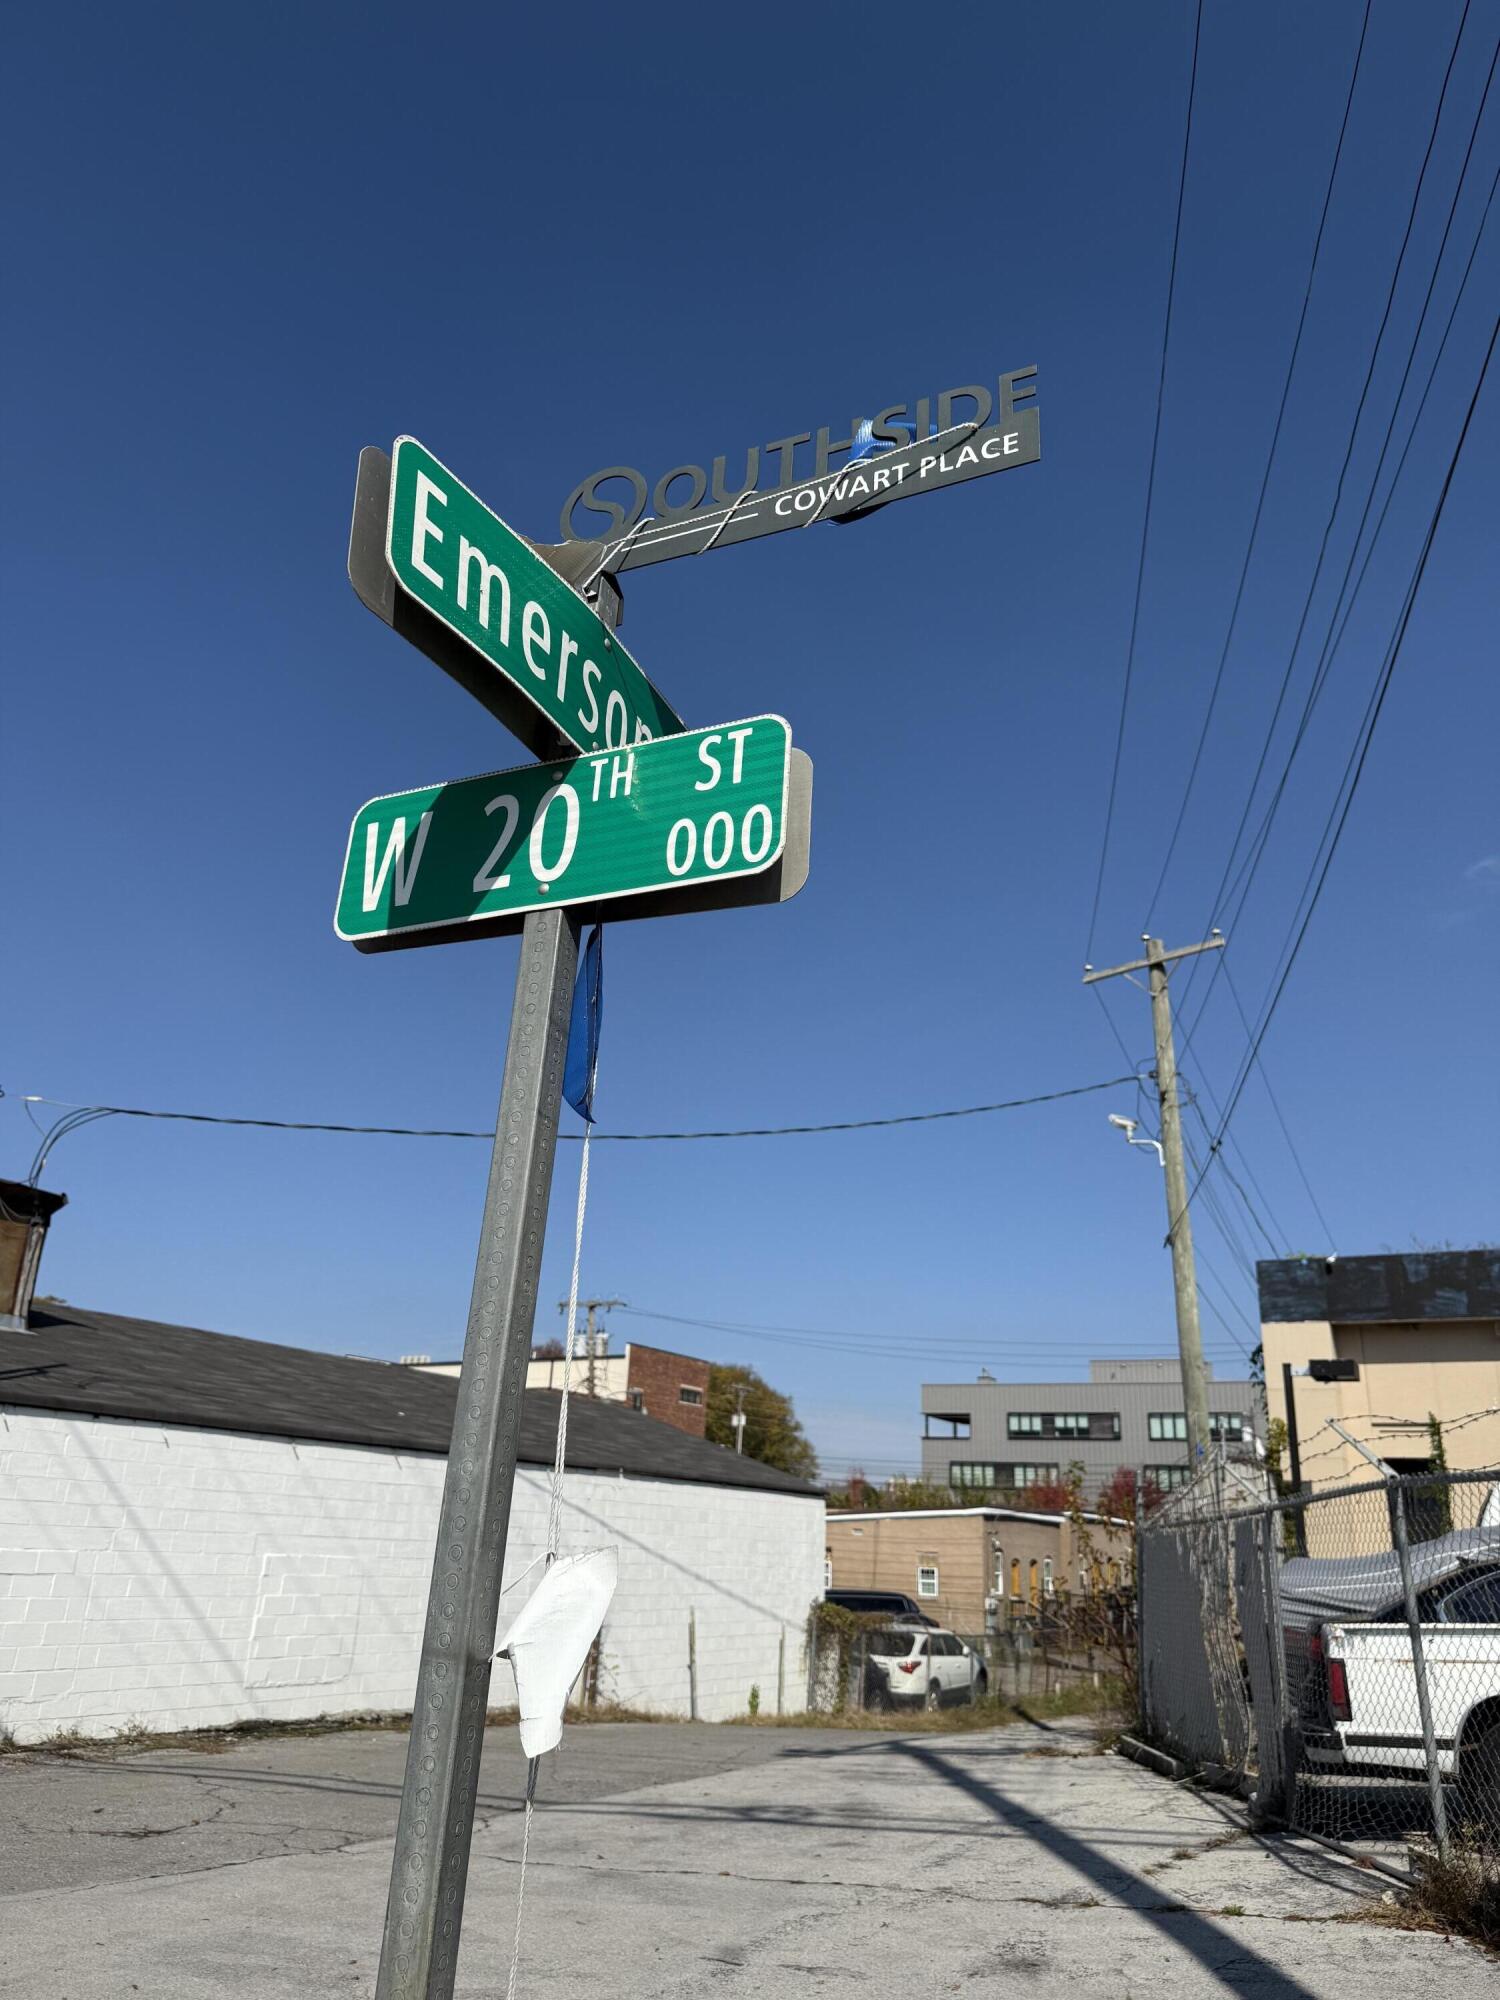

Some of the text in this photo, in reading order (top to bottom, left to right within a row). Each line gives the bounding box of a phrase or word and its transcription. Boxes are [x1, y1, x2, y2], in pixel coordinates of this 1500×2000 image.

[774, 432, 1019, 516] COWART PLACE
[361, 811, 433, 912] W
[694, 727, 754, 791] ST
[666, 803, 773, 876] 000
